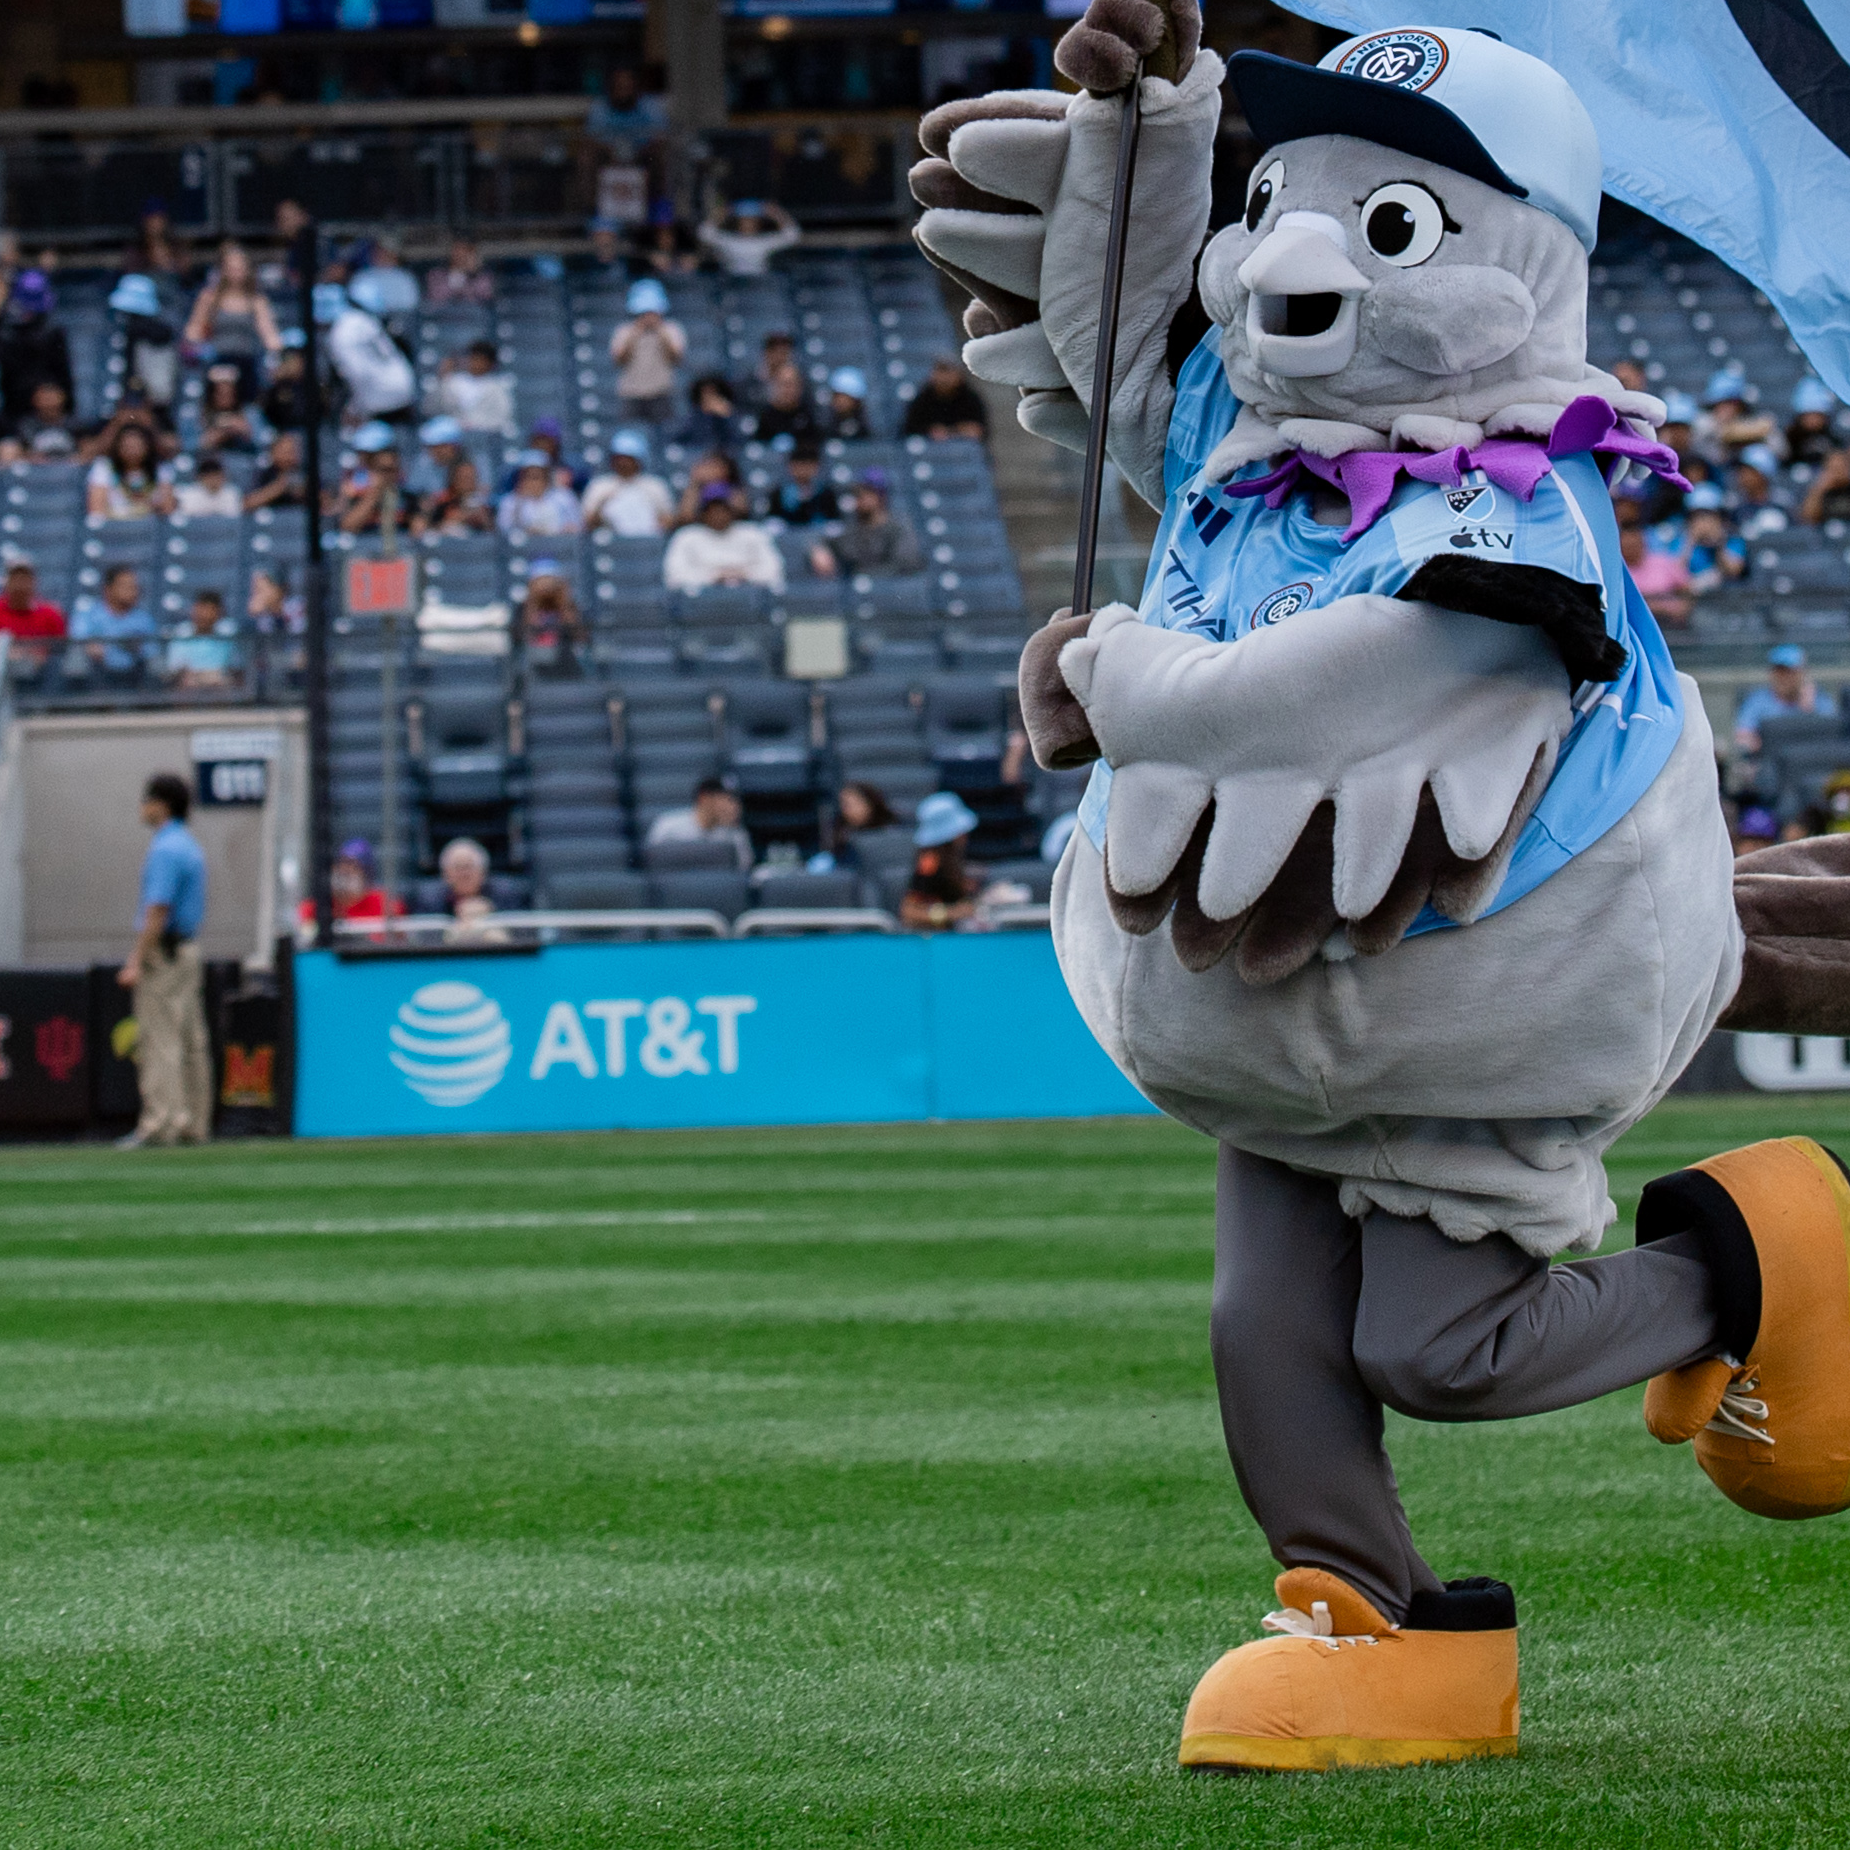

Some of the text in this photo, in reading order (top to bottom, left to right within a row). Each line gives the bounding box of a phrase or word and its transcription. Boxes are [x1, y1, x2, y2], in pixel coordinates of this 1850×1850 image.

[1357, 34, 1440, 69] NEW YORK CITY
[1449, 490, 1475, 503] MLS
[1477, 528, 1514, 549] tv
[530, 995, 758, 1080] AT&T
